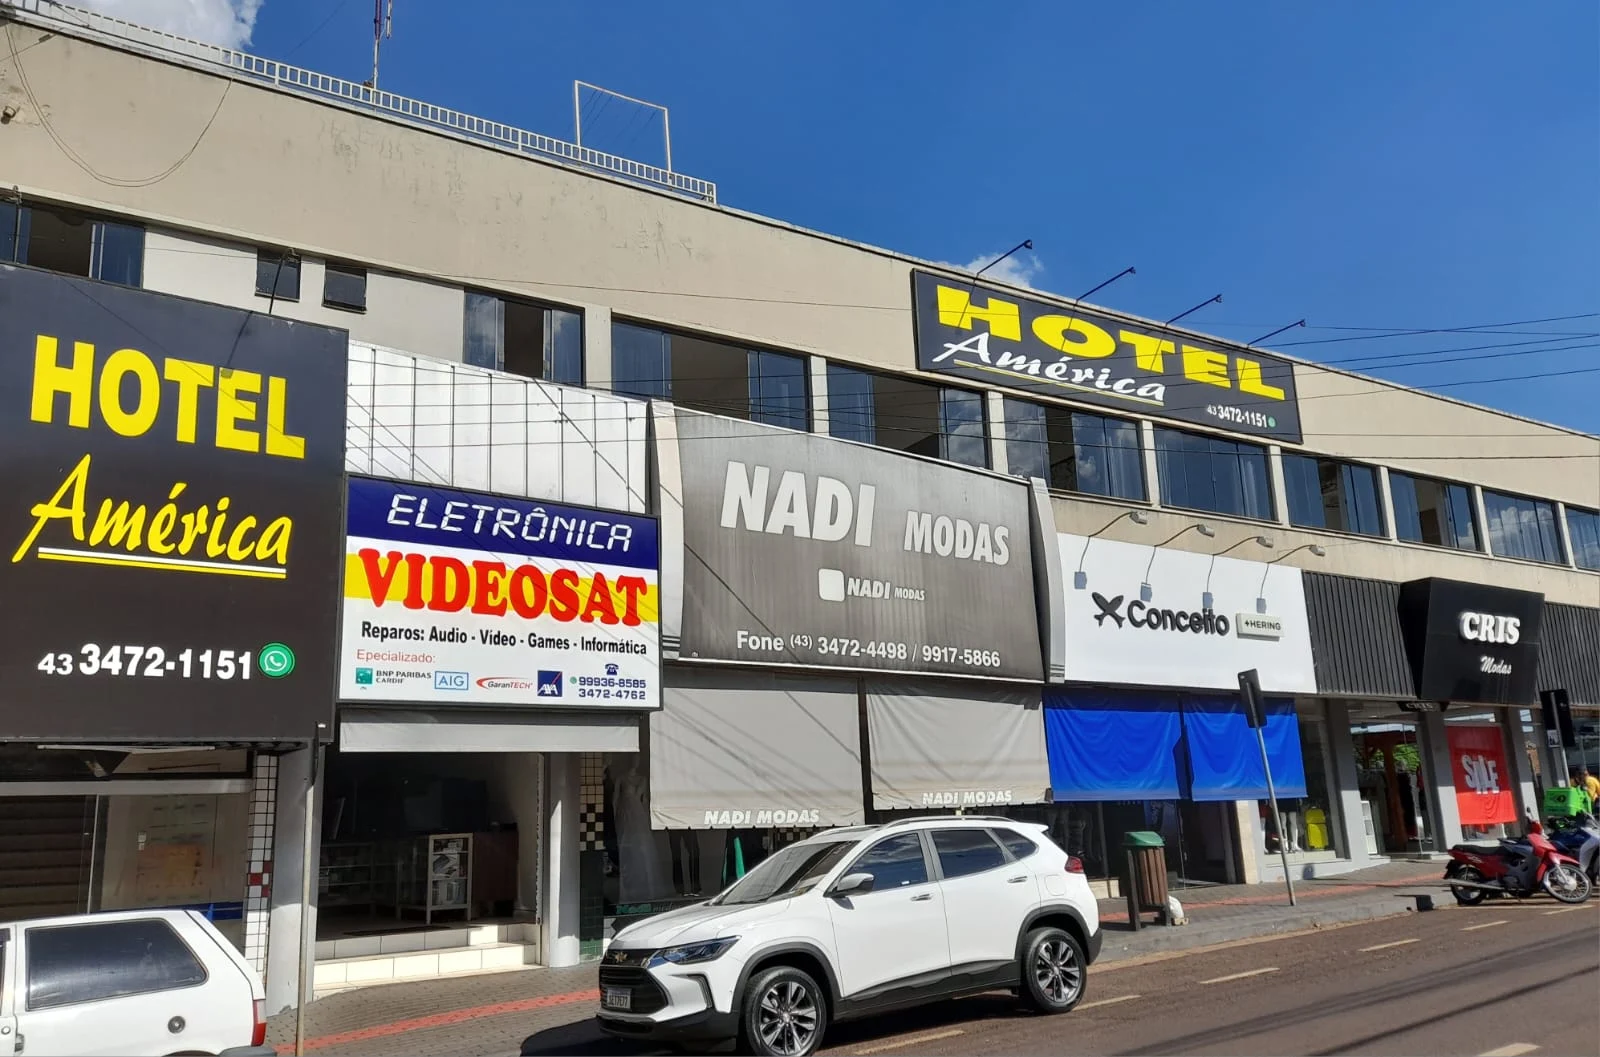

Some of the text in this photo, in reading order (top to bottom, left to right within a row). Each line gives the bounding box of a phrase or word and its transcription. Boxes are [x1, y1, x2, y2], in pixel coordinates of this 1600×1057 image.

[937, 285, 1285, 400] HOTEL
[932, 332, 1165, 401] América
[31, 335, 305, 459] HOTEL
[1207, 404, 1267, 428] 43 3472-1151
[12, 453, 292, 565] América
[387, 494, 633, 552] ELETRÔNICA
[720, 461, 1010, 566] NADI MODAS
[358, 548, 648, 627] VIDEOSAT
[847, 577, 925, 601] NADI MODAS
[1127, 600, 1230, 636] Conceito
[1460, 612, 1520, 645] CRIS
[361, 621, 425, 642] Reparos:
[429, 626, 468, 643] Audio
[528, 633, 570, 650] Games
[581, 636, 647, 655] Informática
[736, 630, 784, 651] Fone
[790, 634, 813, 649] (43)
[818, 636, 907, 660] 3472-4498
[922, 645, 1001, 667] 9917-5866
[38, 643, 251, 680] 43 3472-1151
[356, 649, 436, 664] Epecializado:
[1480, 655, 1512, 675] Modas
[438, 675, 465, 687] AIG
[578, 676, 646, 689] 99936-8585
[578, 688, 646, 700] 3472-4762
[922, 790, 1013, 805] NADI MODAS
[704, 809, 820, 825] NADI MODAS
